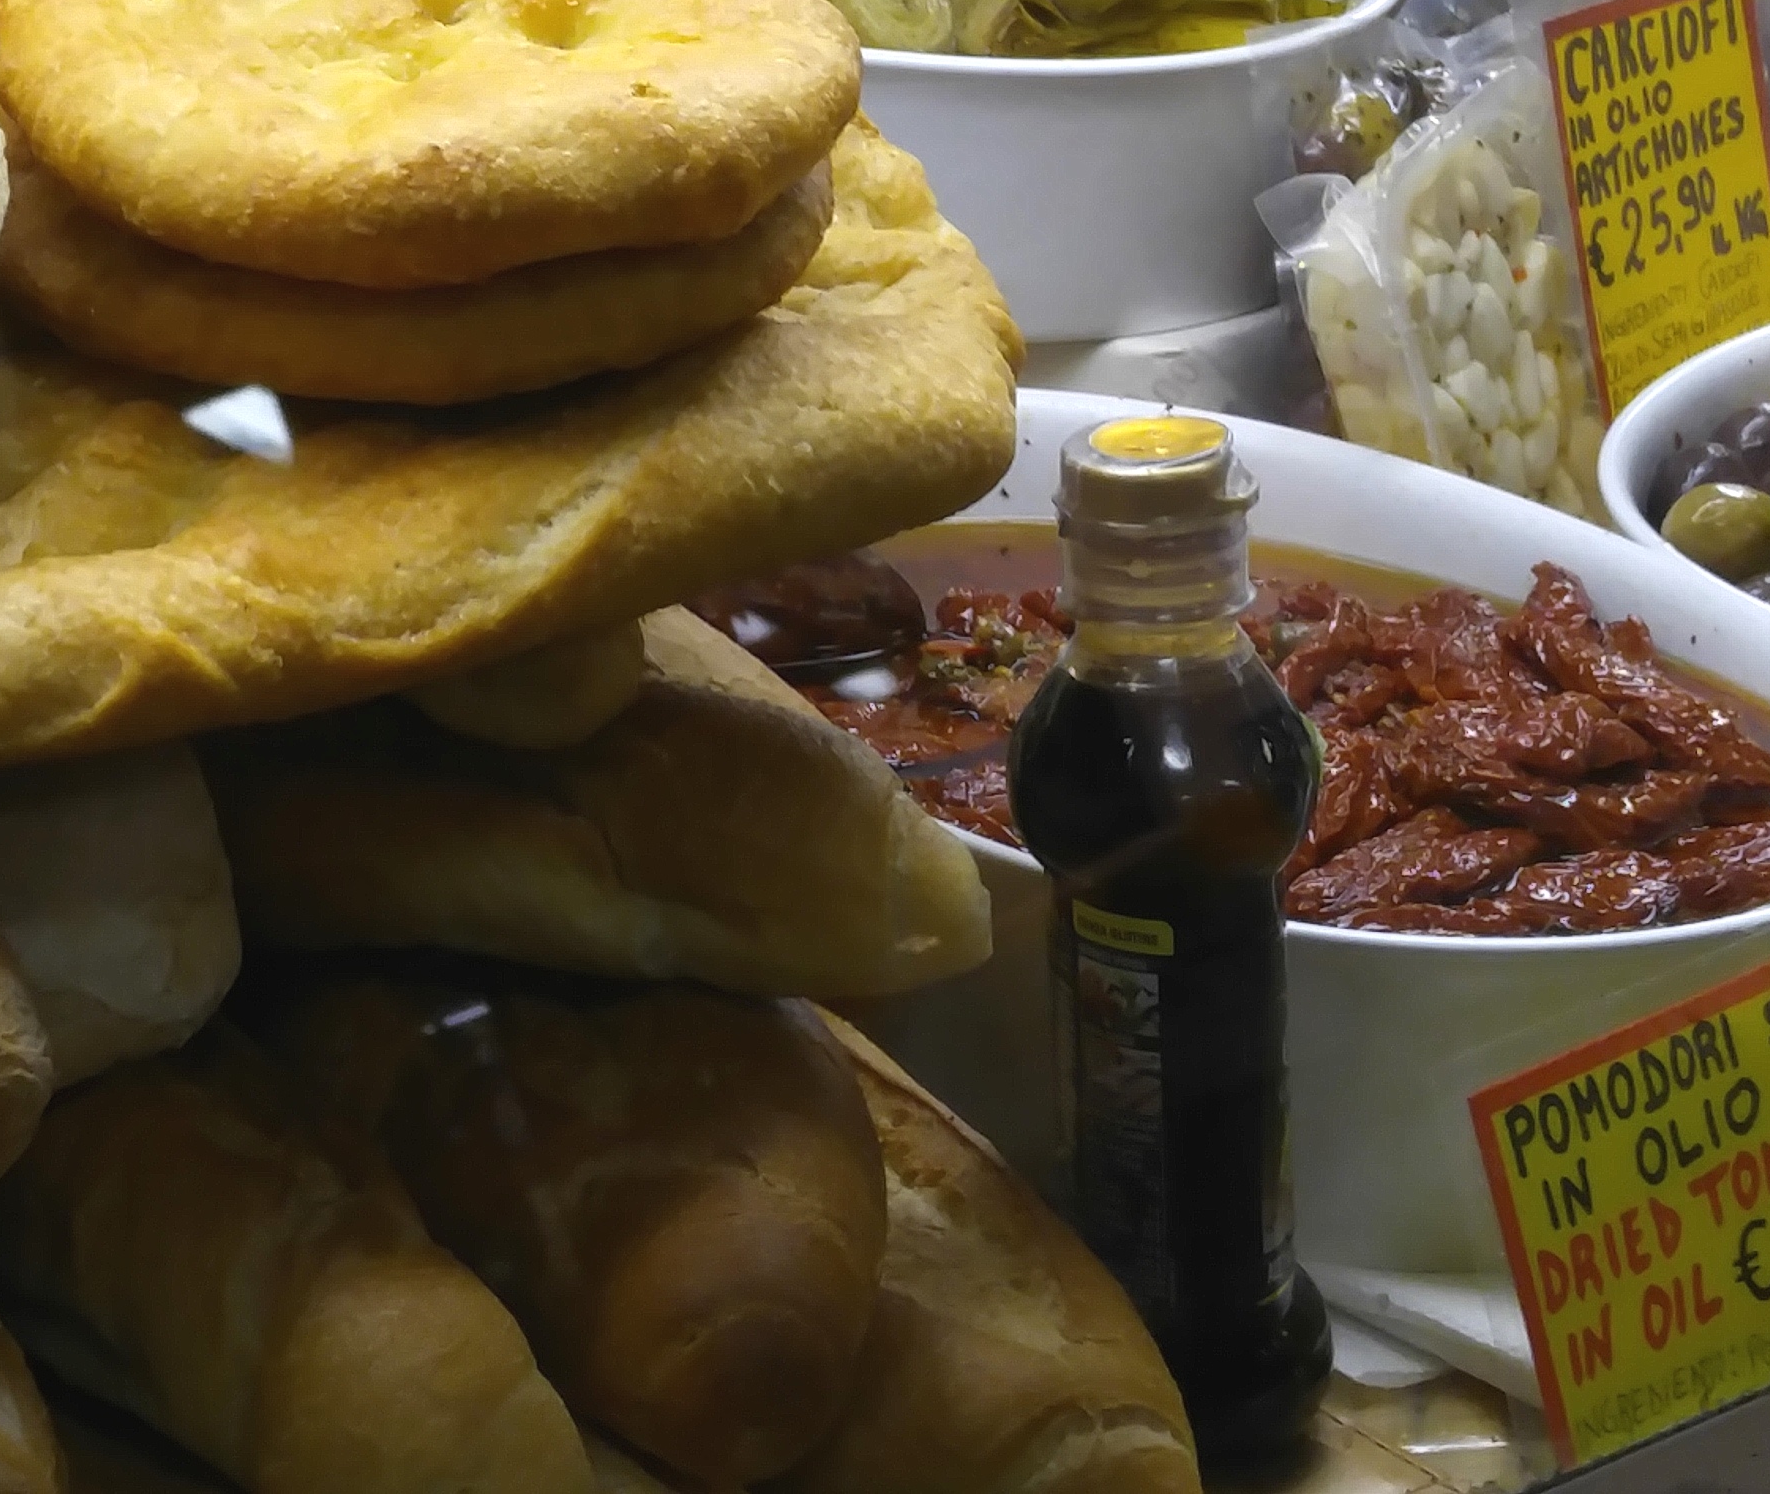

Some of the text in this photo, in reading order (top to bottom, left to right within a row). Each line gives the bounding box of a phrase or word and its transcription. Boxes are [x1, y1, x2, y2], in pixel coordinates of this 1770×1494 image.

[1569, 78, 1674, 154] IN OLIO
[1575, 95, 1746, 210] ARTICHOKES
[1504, 1012, 1740, 1179] POMODORI
[1542, 1076, 1761, 1231] IN OLIO
[1537, 1197, 1683, 1316] DRIED
[1567, 1303, 1613, 1386] IN
[1641, 1263, 1725, 1351] OIL
